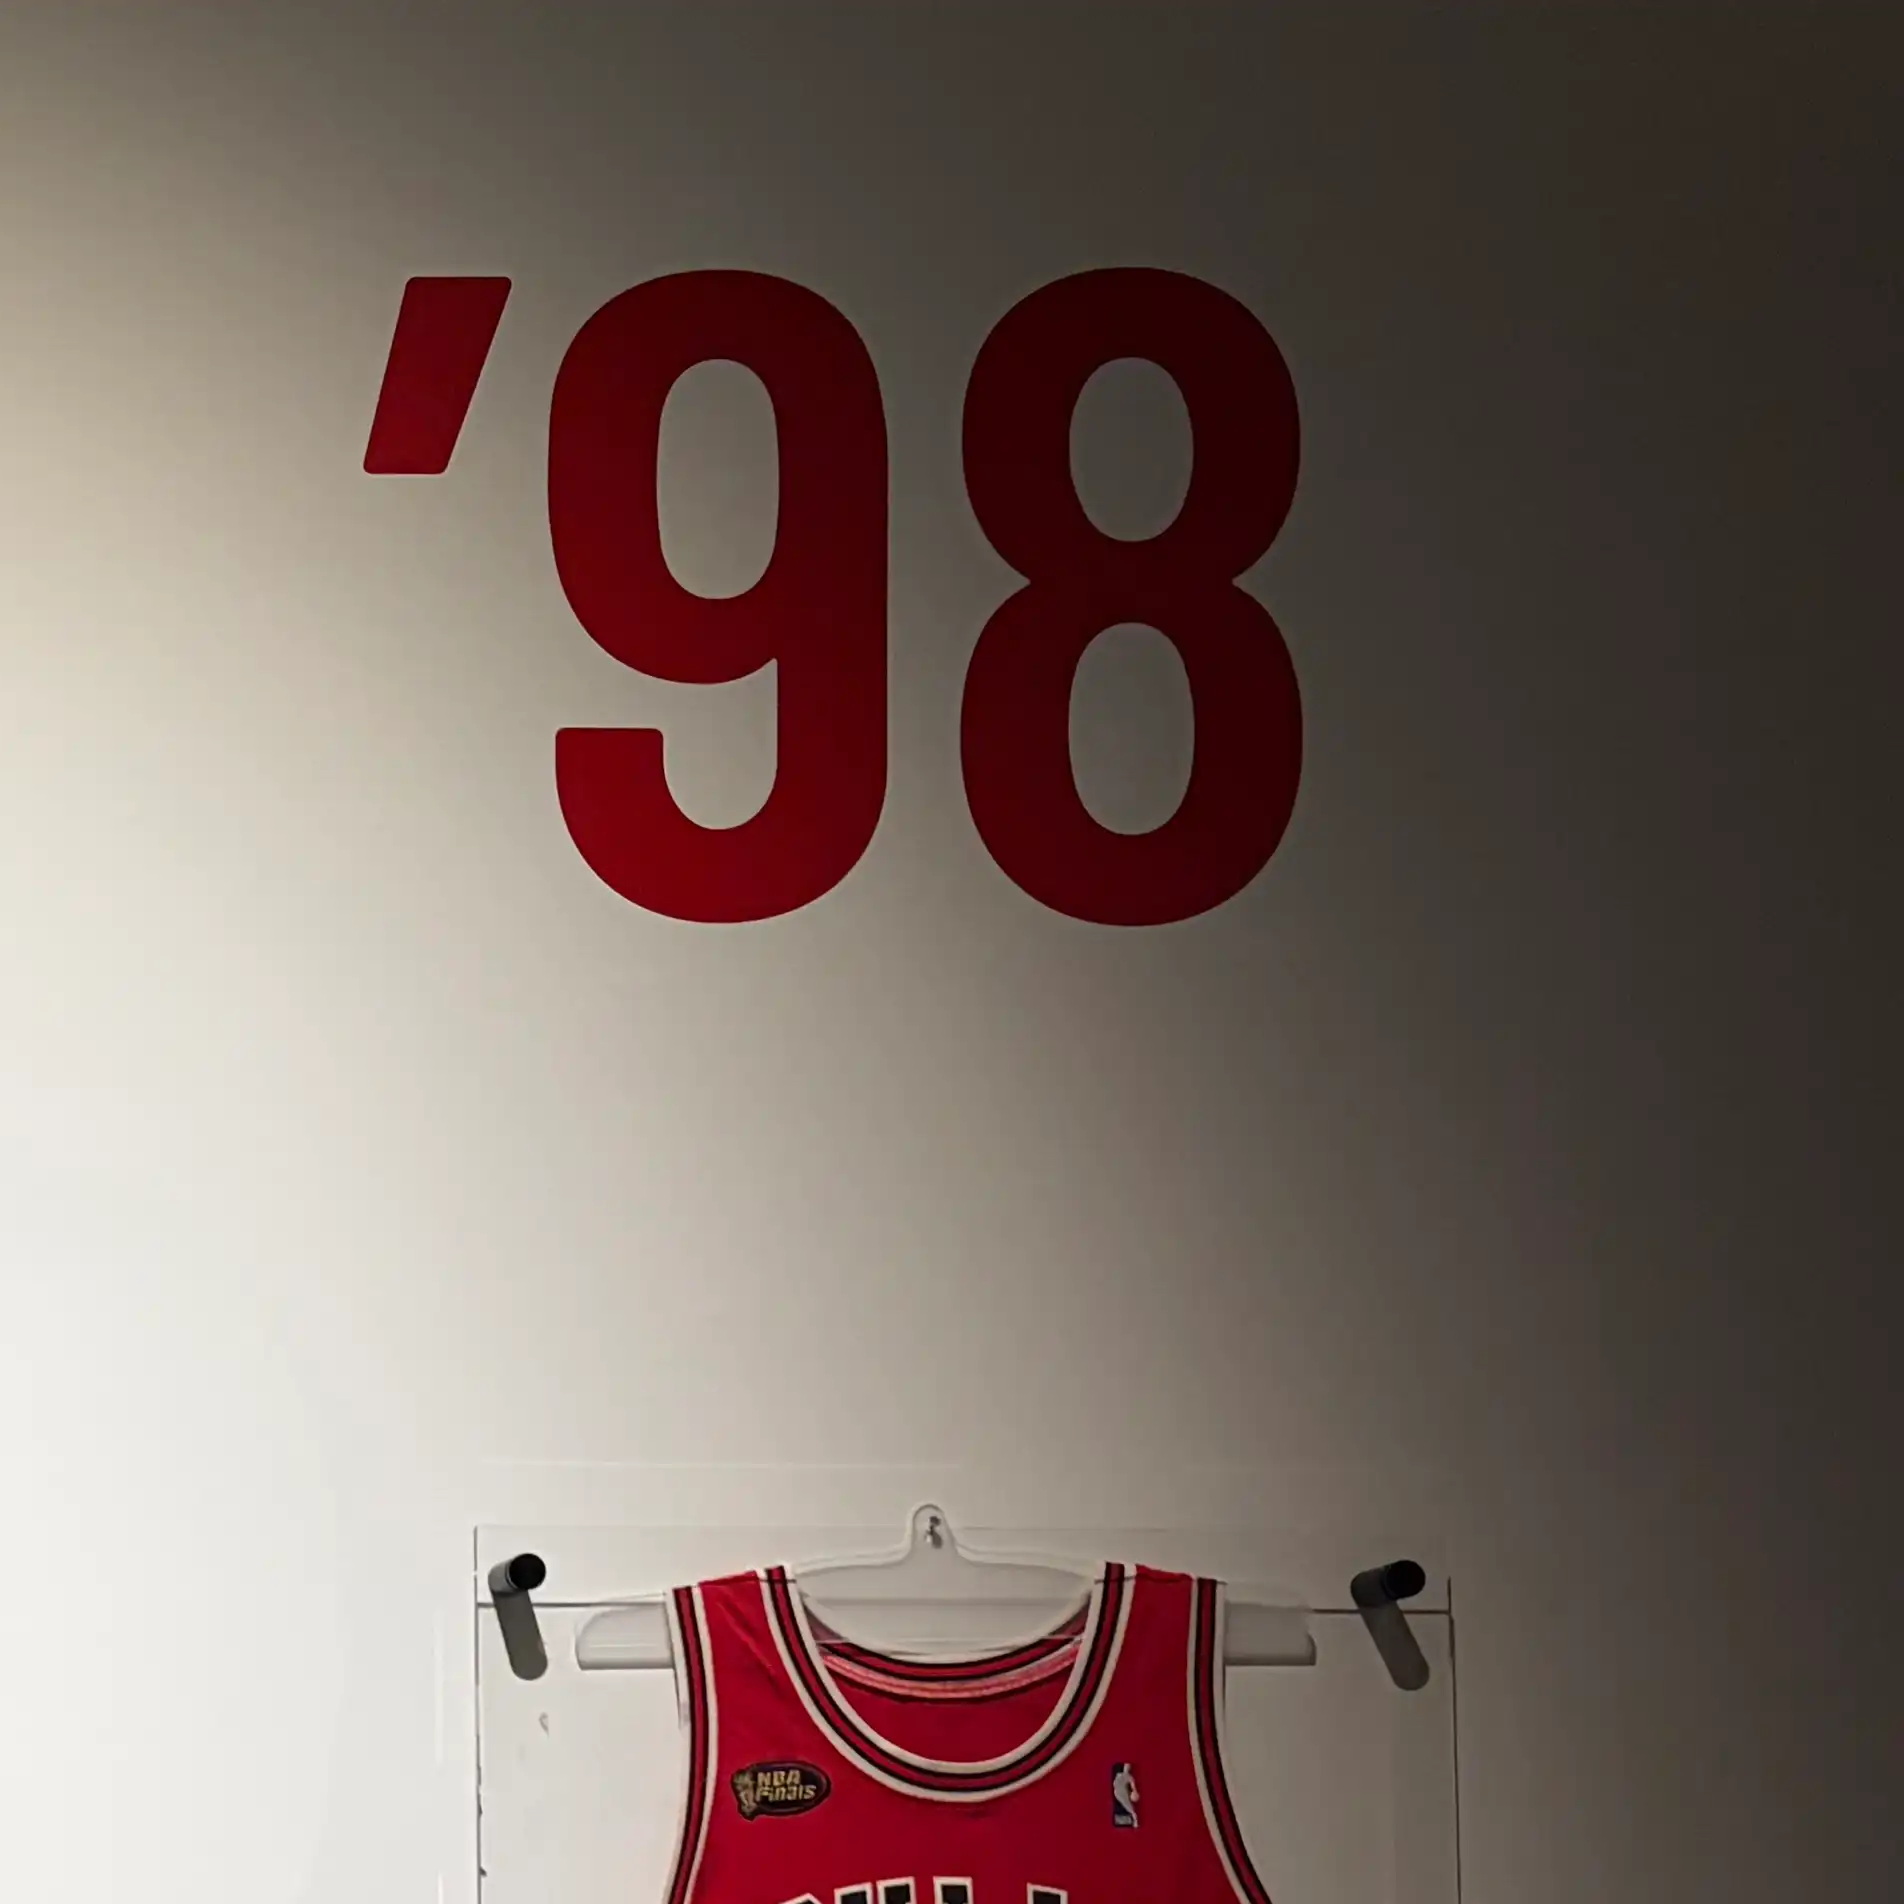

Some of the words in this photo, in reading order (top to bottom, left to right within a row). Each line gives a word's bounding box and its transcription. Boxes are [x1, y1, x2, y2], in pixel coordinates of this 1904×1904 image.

[363, 267, 1302, 927] '98
[756, 1769, 801, 1787] NBA
[755, 1784, 817, 1802] Finals
